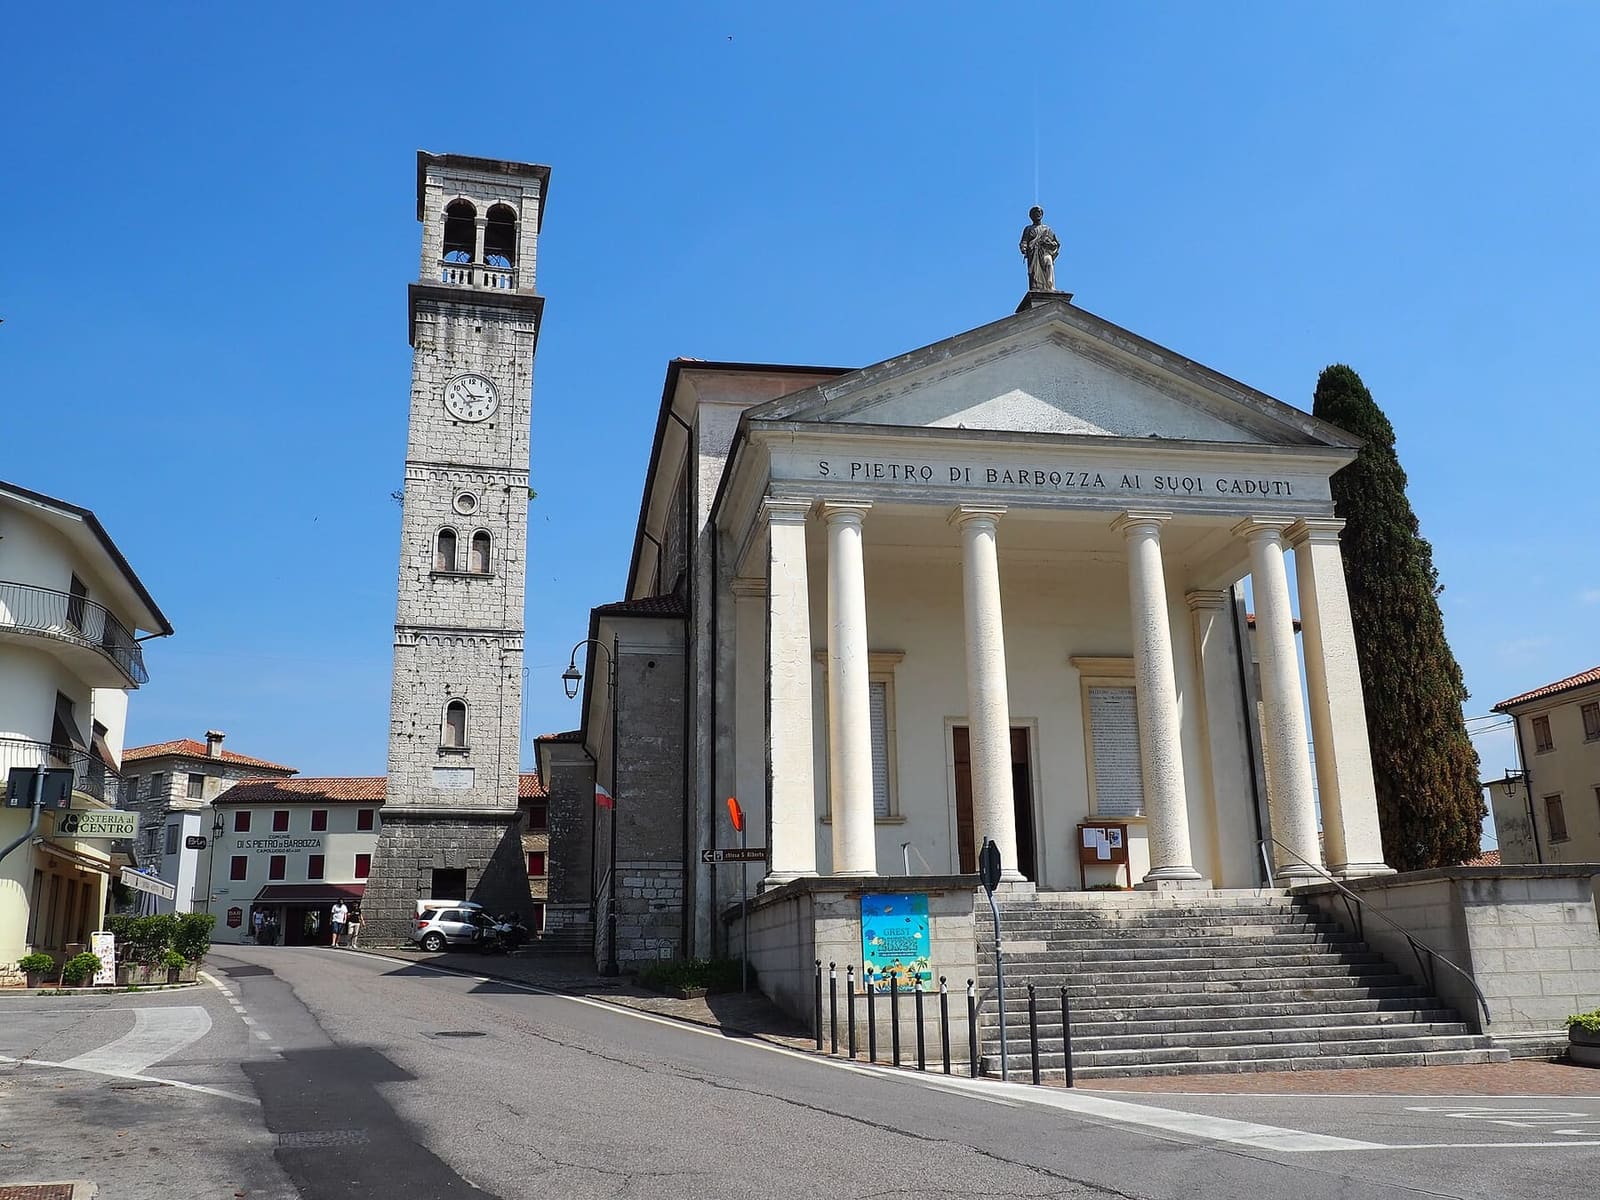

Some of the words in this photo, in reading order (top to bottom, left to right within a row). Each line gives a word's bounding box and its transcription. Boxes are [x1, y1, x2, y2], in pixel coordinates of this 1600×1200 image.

[819, 461, 837, 476] S.
[851, 463, 933, 480] PIETRO
[949, 466, 971, 482] DI
[986, 468, 1106, 489] BARBOZZA
[1119, 474, 1141, 489] AI
[1154, 475, 1204, 493] SUOI
[1215, 478, 1293, 496] CADUTI
[81, 815, 124, 823] OSTERIA
[80, 823, 134, 833] CENTRO
[253, 840, 278, 848] PIETRO
[284, 839, 321, 848] BARBOZZA
[883, 927, 910, 936] GREST
